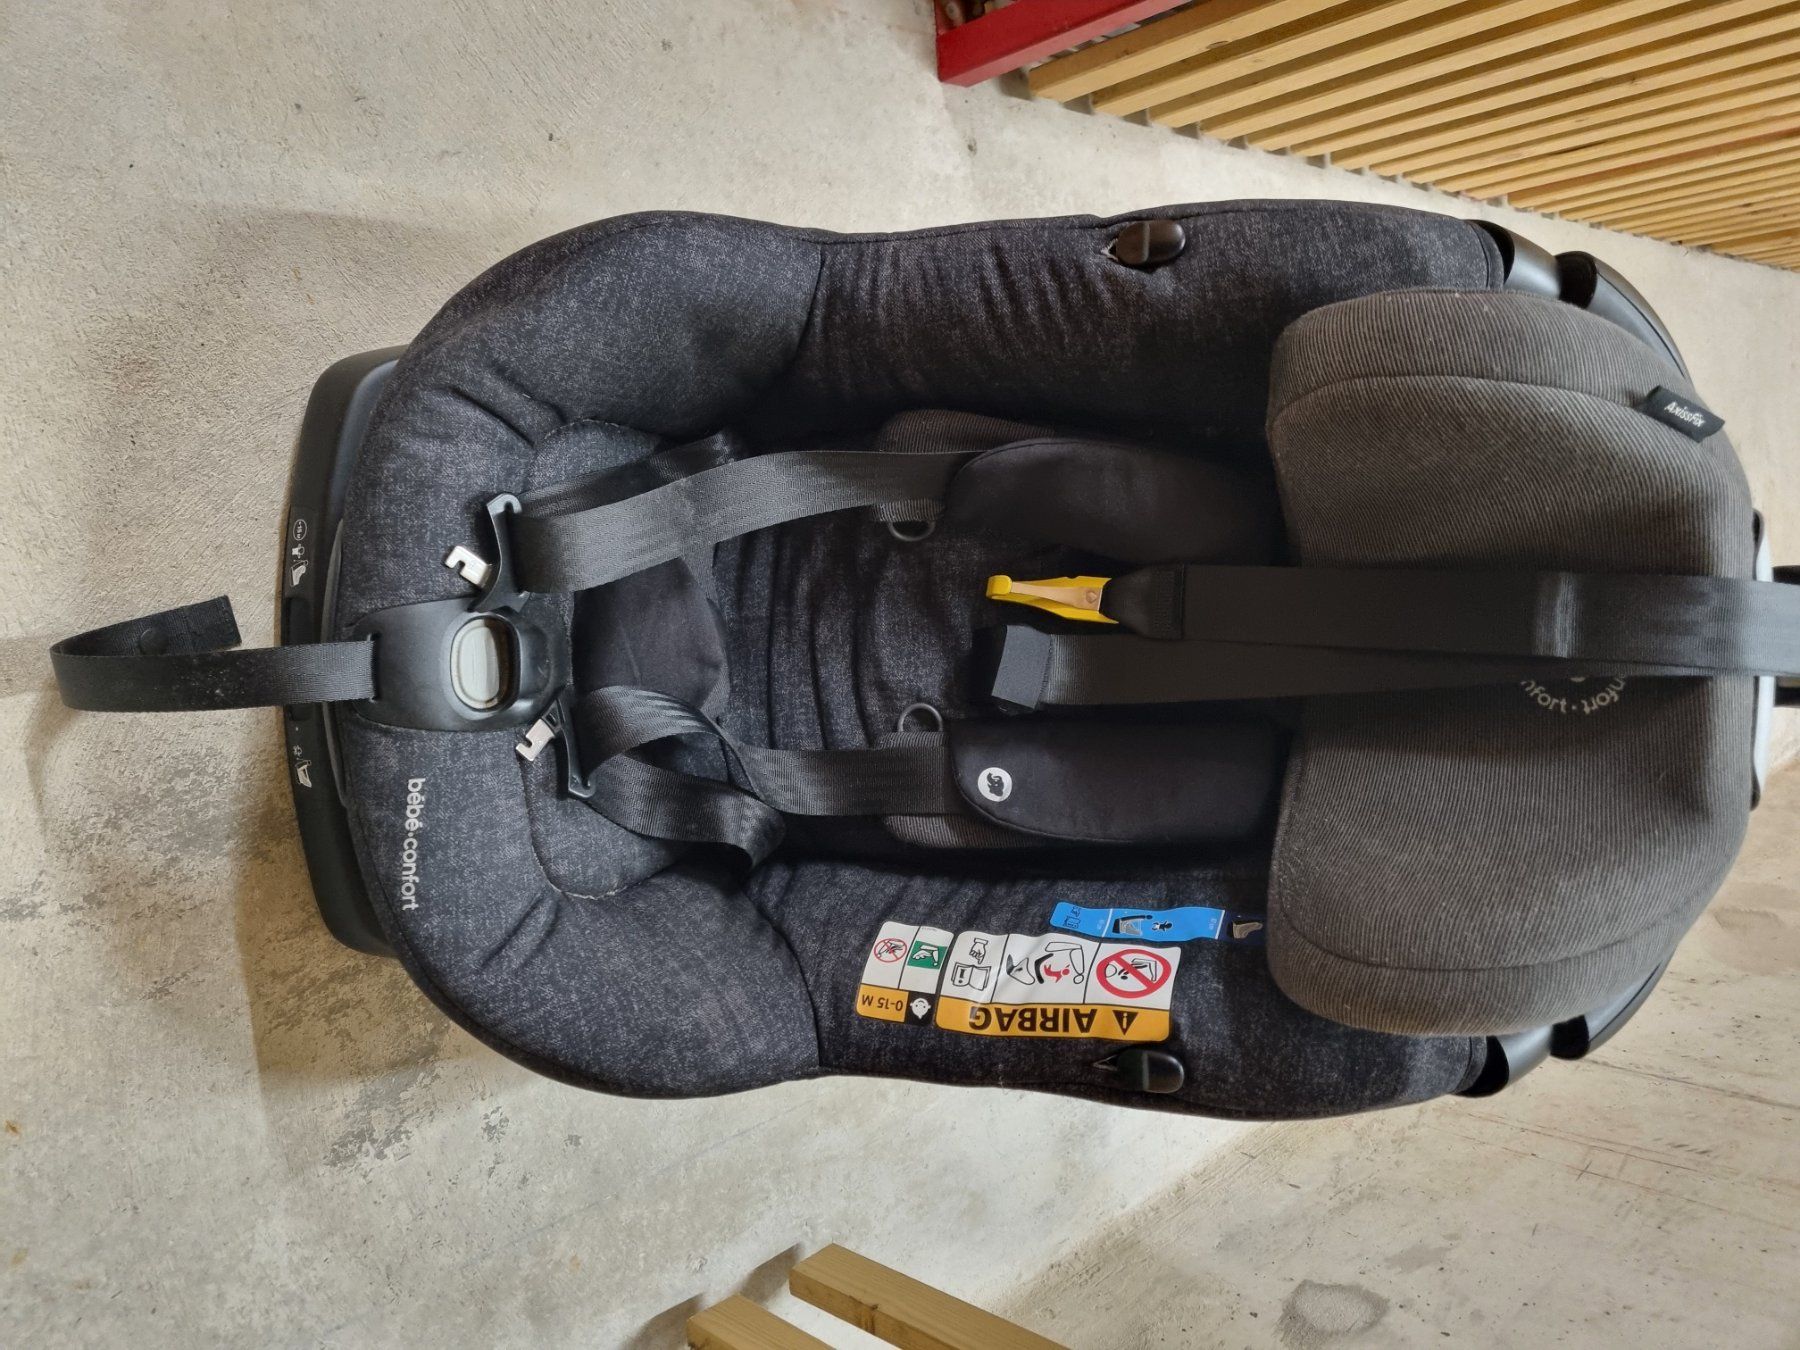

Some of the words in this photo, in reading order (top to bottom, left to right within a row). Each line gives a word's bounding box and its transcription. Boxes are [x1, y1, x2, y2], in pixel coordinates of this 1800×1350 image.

[862, 994, 874, 1006] M
[877, 997, 903, 1011] 0-15
[969, 1006, 1098, 1033] AIRBAG
